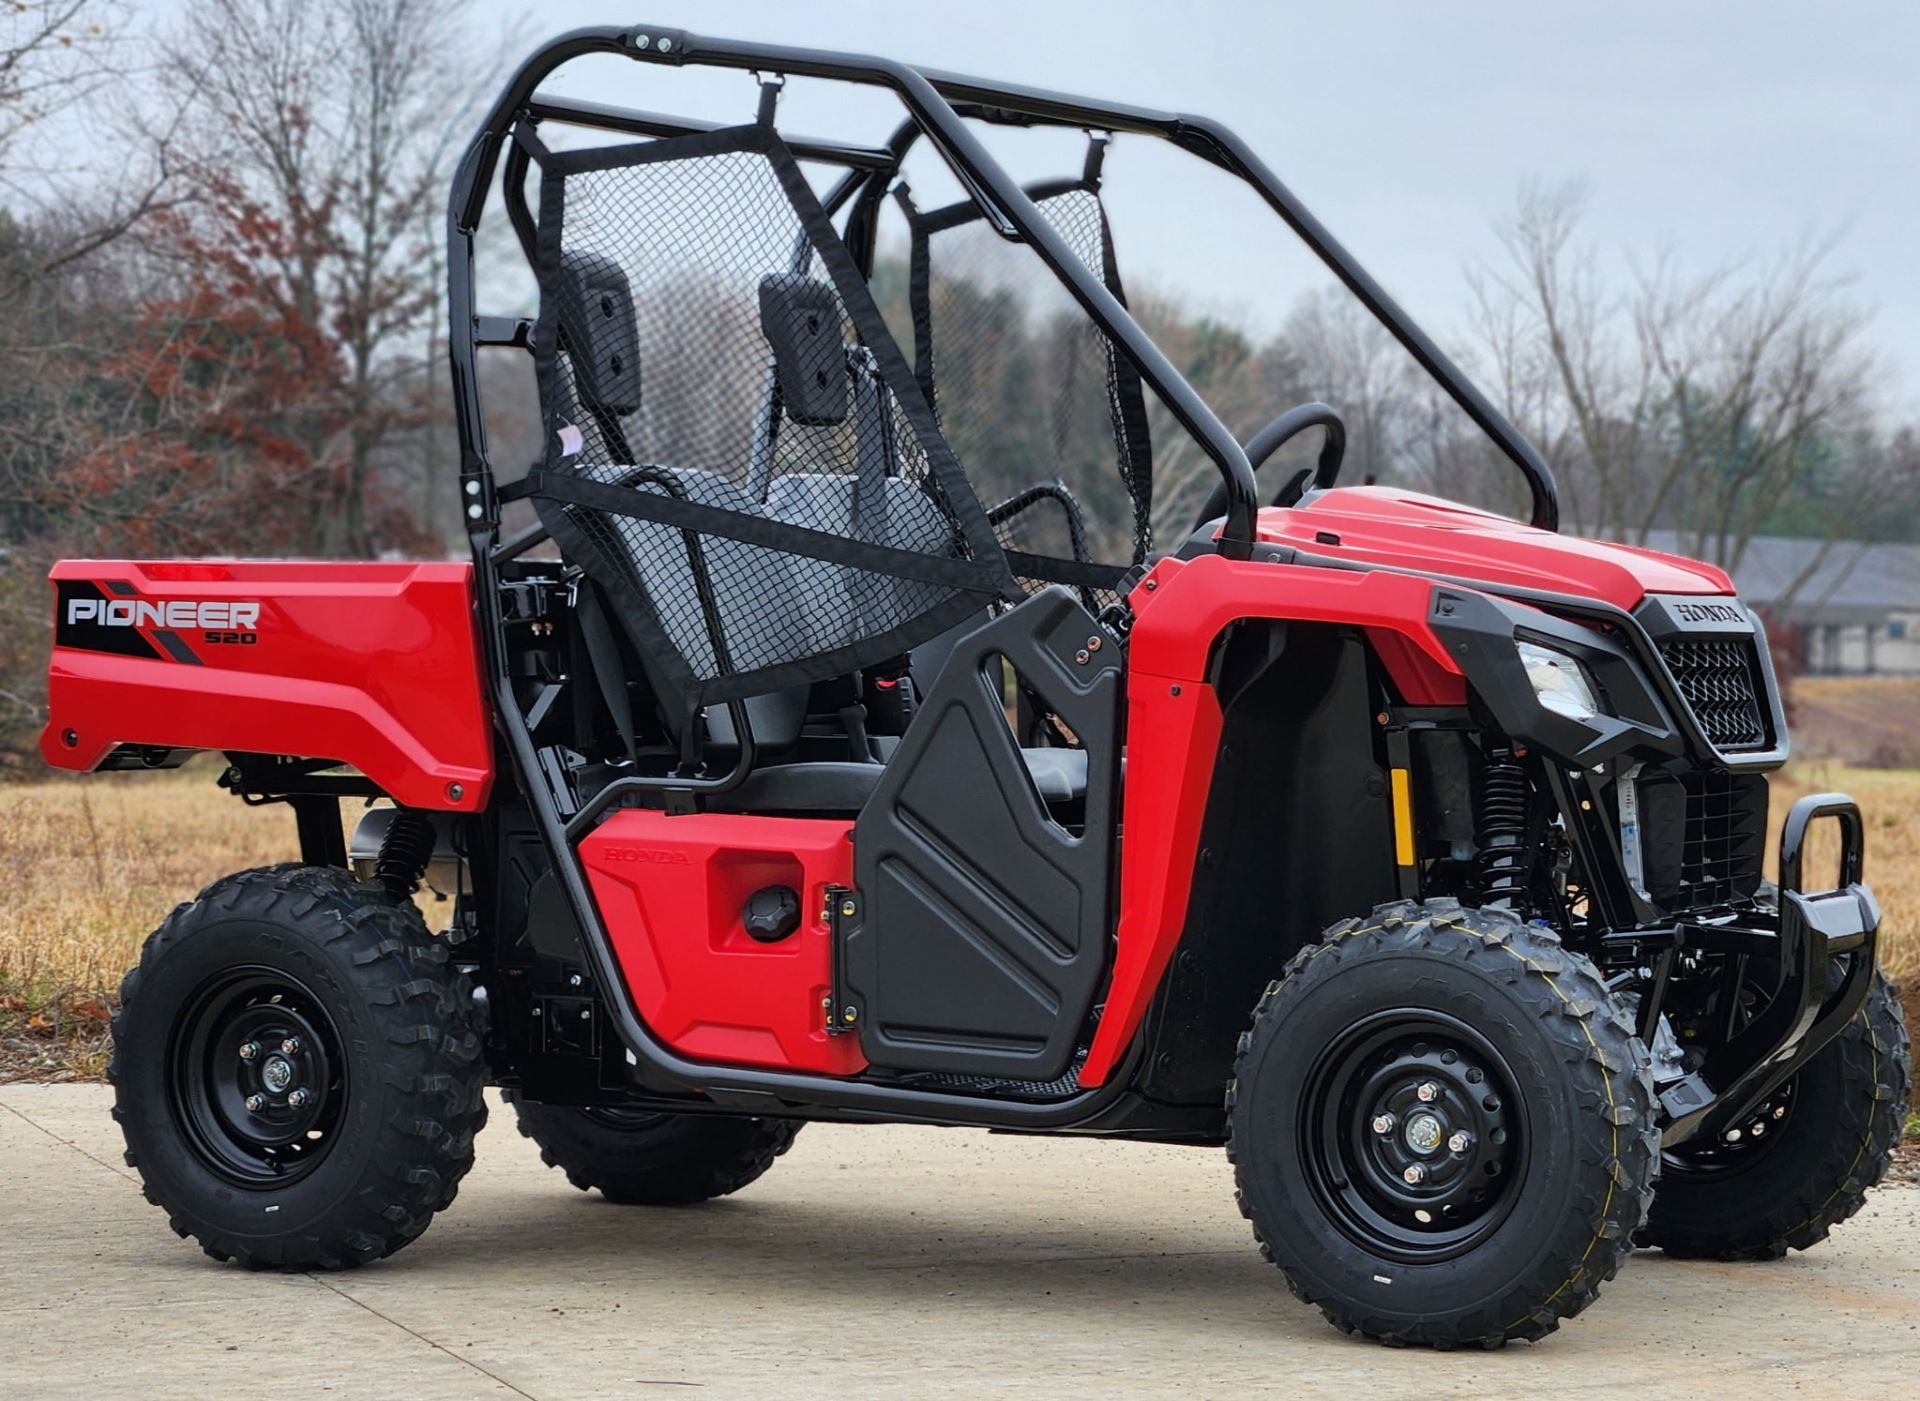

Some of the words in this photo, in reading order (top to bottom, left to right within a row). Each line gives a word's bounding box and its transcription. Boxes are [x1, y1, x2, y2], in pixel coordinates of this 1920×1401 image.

[68, 599, 260, 629] PIONEER
[1673, 604, 1745, 623] HONDA
[204, 631, 257, 644] 520
[603, 846, 692, 866] HONDA
